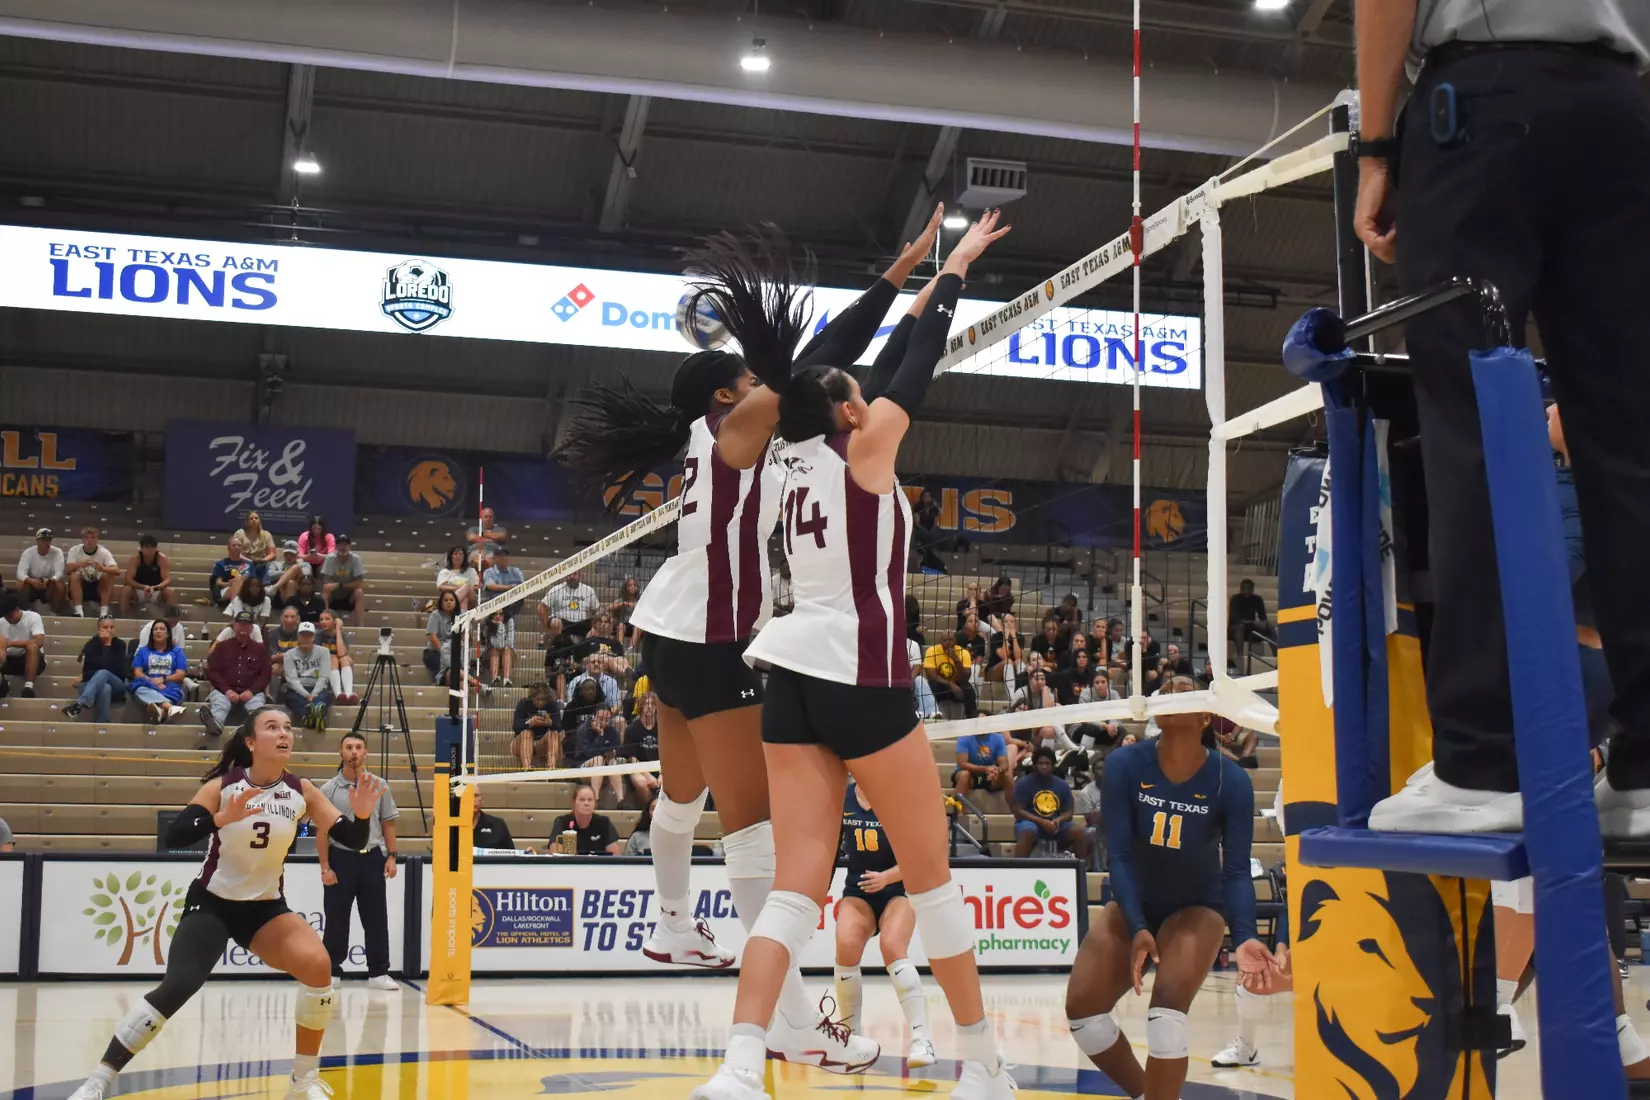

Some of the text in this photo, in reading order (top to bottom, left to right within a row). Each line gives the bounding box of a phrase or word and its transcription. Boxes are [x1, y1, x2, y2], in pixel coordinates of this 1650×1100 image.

[49, 242, 279, 273] EAST TEXAS A&M
[1059, 272, 1081, 290] EAST
[1082, 250, 1110, 277] TEXAS
[50, 258, 278, 311] LIONS
[384, 281, 449, 304] LOREDO
[601, 301, 681, 332] Dom
[980, 318, 998, 336] EAST
[998, 302, 1022, 323] TEXAS
[1025, 318, 1188, 341] ST TEXAS A&M
[1008, 331, 1188, 375] LIONS
[0, 430, 77, 470] LL
[209, 435, 307, 486] Fix &
[0, 473, 60, 498] CANS
[223, 472, 313, 513] Feed
[784, 486, 828, 555] 14
[268, 803, 296, 820] ILLINOIS
[1138, 791, 1209, 814] EAST TEXAS
[249, 821, 271, 849] 3
[842, 818, 863, 827] EAST
[1149, 811, 1183, 850] 11
[495, 891, 568, 912] Hilton
[580, 889, 655, 919] BEST
[447, 887, 458, 957] sports imports
[501, 915, 562, 923] DALLAS/ROCKWALL
[513, 922, 550, 930] LAKEFRONT
[582, 921, 618, 952] TO
[978, 933, 1071, 956] pharmacy
